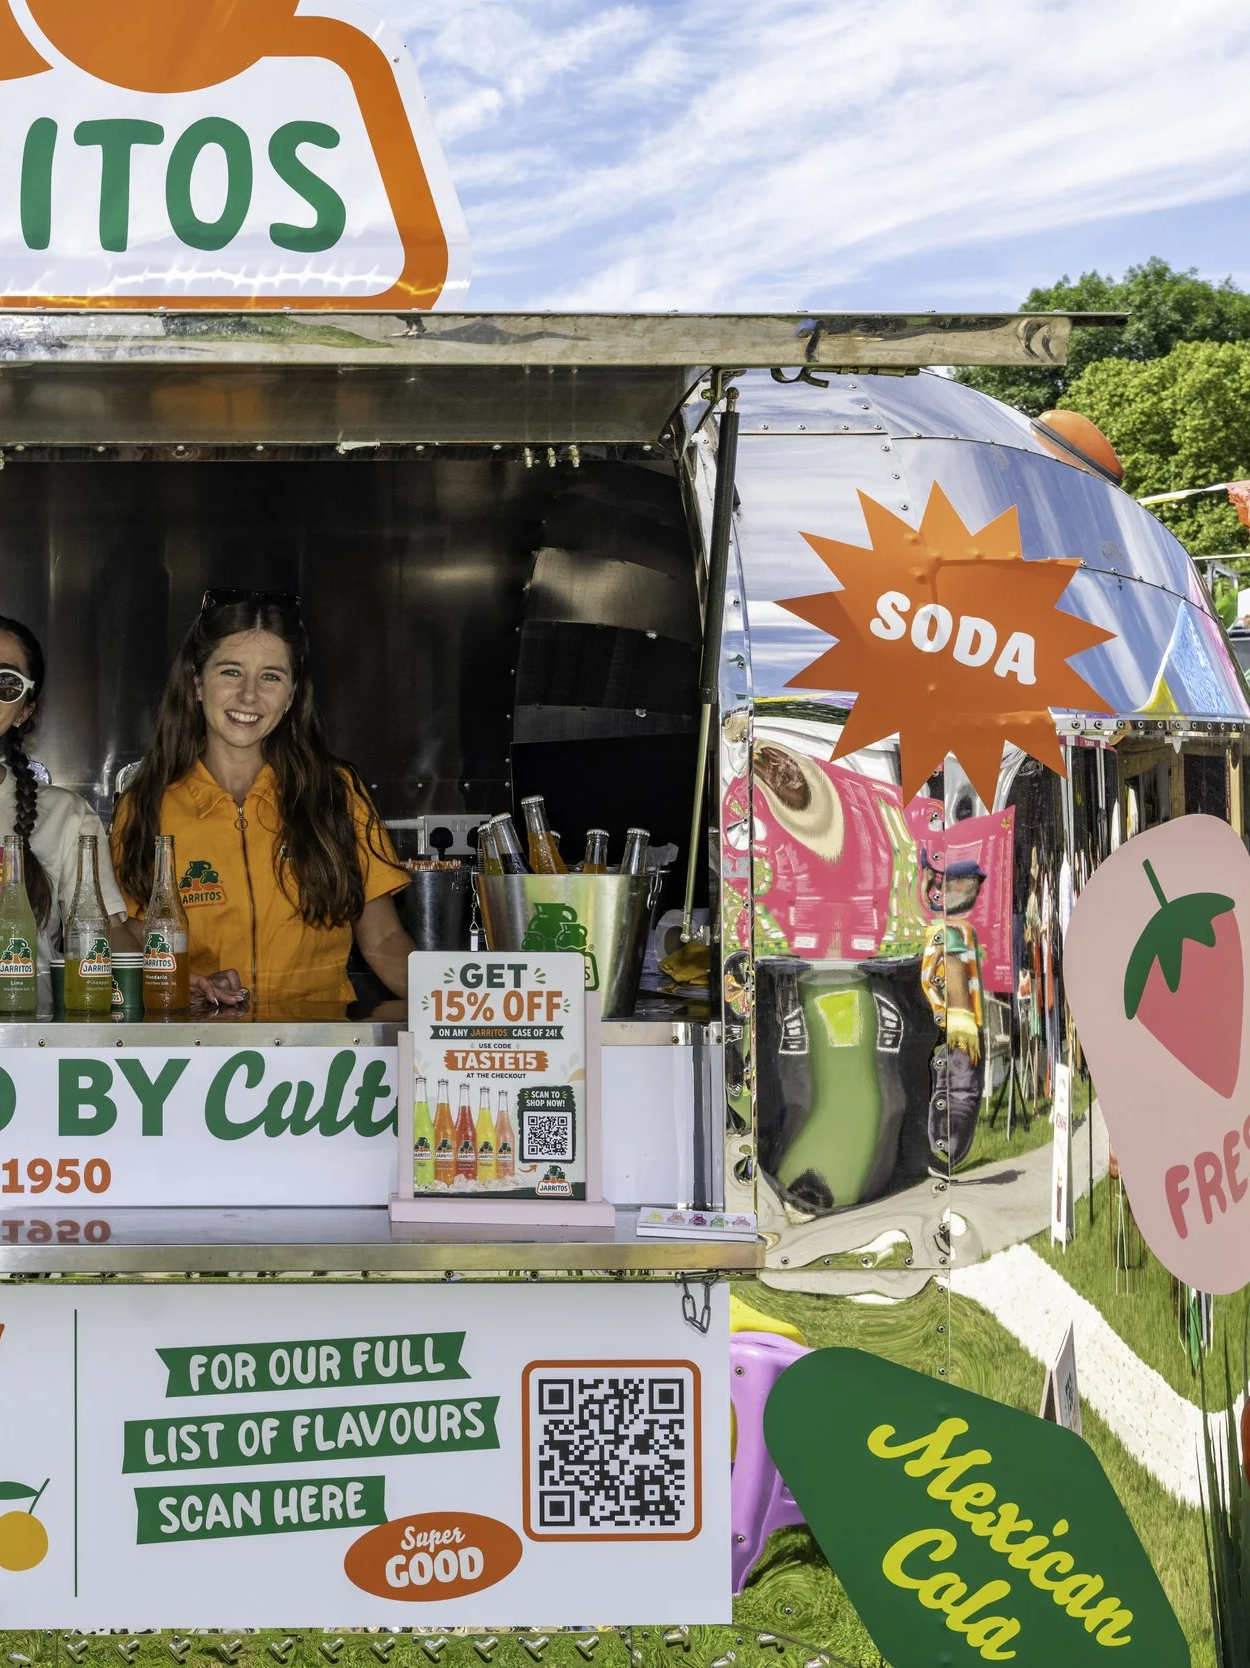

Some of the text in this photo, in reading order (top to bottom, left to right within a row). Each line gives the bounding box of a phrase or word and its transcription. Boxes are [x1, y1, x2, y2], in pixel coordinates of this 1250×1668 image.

[869, 590, 1037, 685] SODA
[183, 891, 221, 904] ARRITOS
[0, 965, 32, 973] JARRITOS
[459, 963, 528, 989] GET
[431, 990, 563, 1022] 15% OFF
[438, 1028, 558, 1037] ON ANY JARRITOS CASE OF 24!
[454, 1052, 538, 1070] TASTE15
[58, 1060, 189, 1137] BY
[205, 1049, 398, 1140] Cult
[526, 1099, 565, 1107] SHOP NOW!
[531, 1091, 561, 1099] SCAN TO
[2, 1158, 111, 1193] 1950
[1165, 1114, 1250, 1239] FRE
[188, 1336, 446, 1393] FOR OUR FULL
[144, 1401, 485, 1466] LIST OF FLAVOURS
[159, 1481, 366, 1535] SCAN HERE
[400, 1525, 465, 1553] Super
[867, 1417, 1134, 1648] Mexican
[384, 1547, 485, 1588] GOOD
[882, 1528, 1022, 1661] Cola
